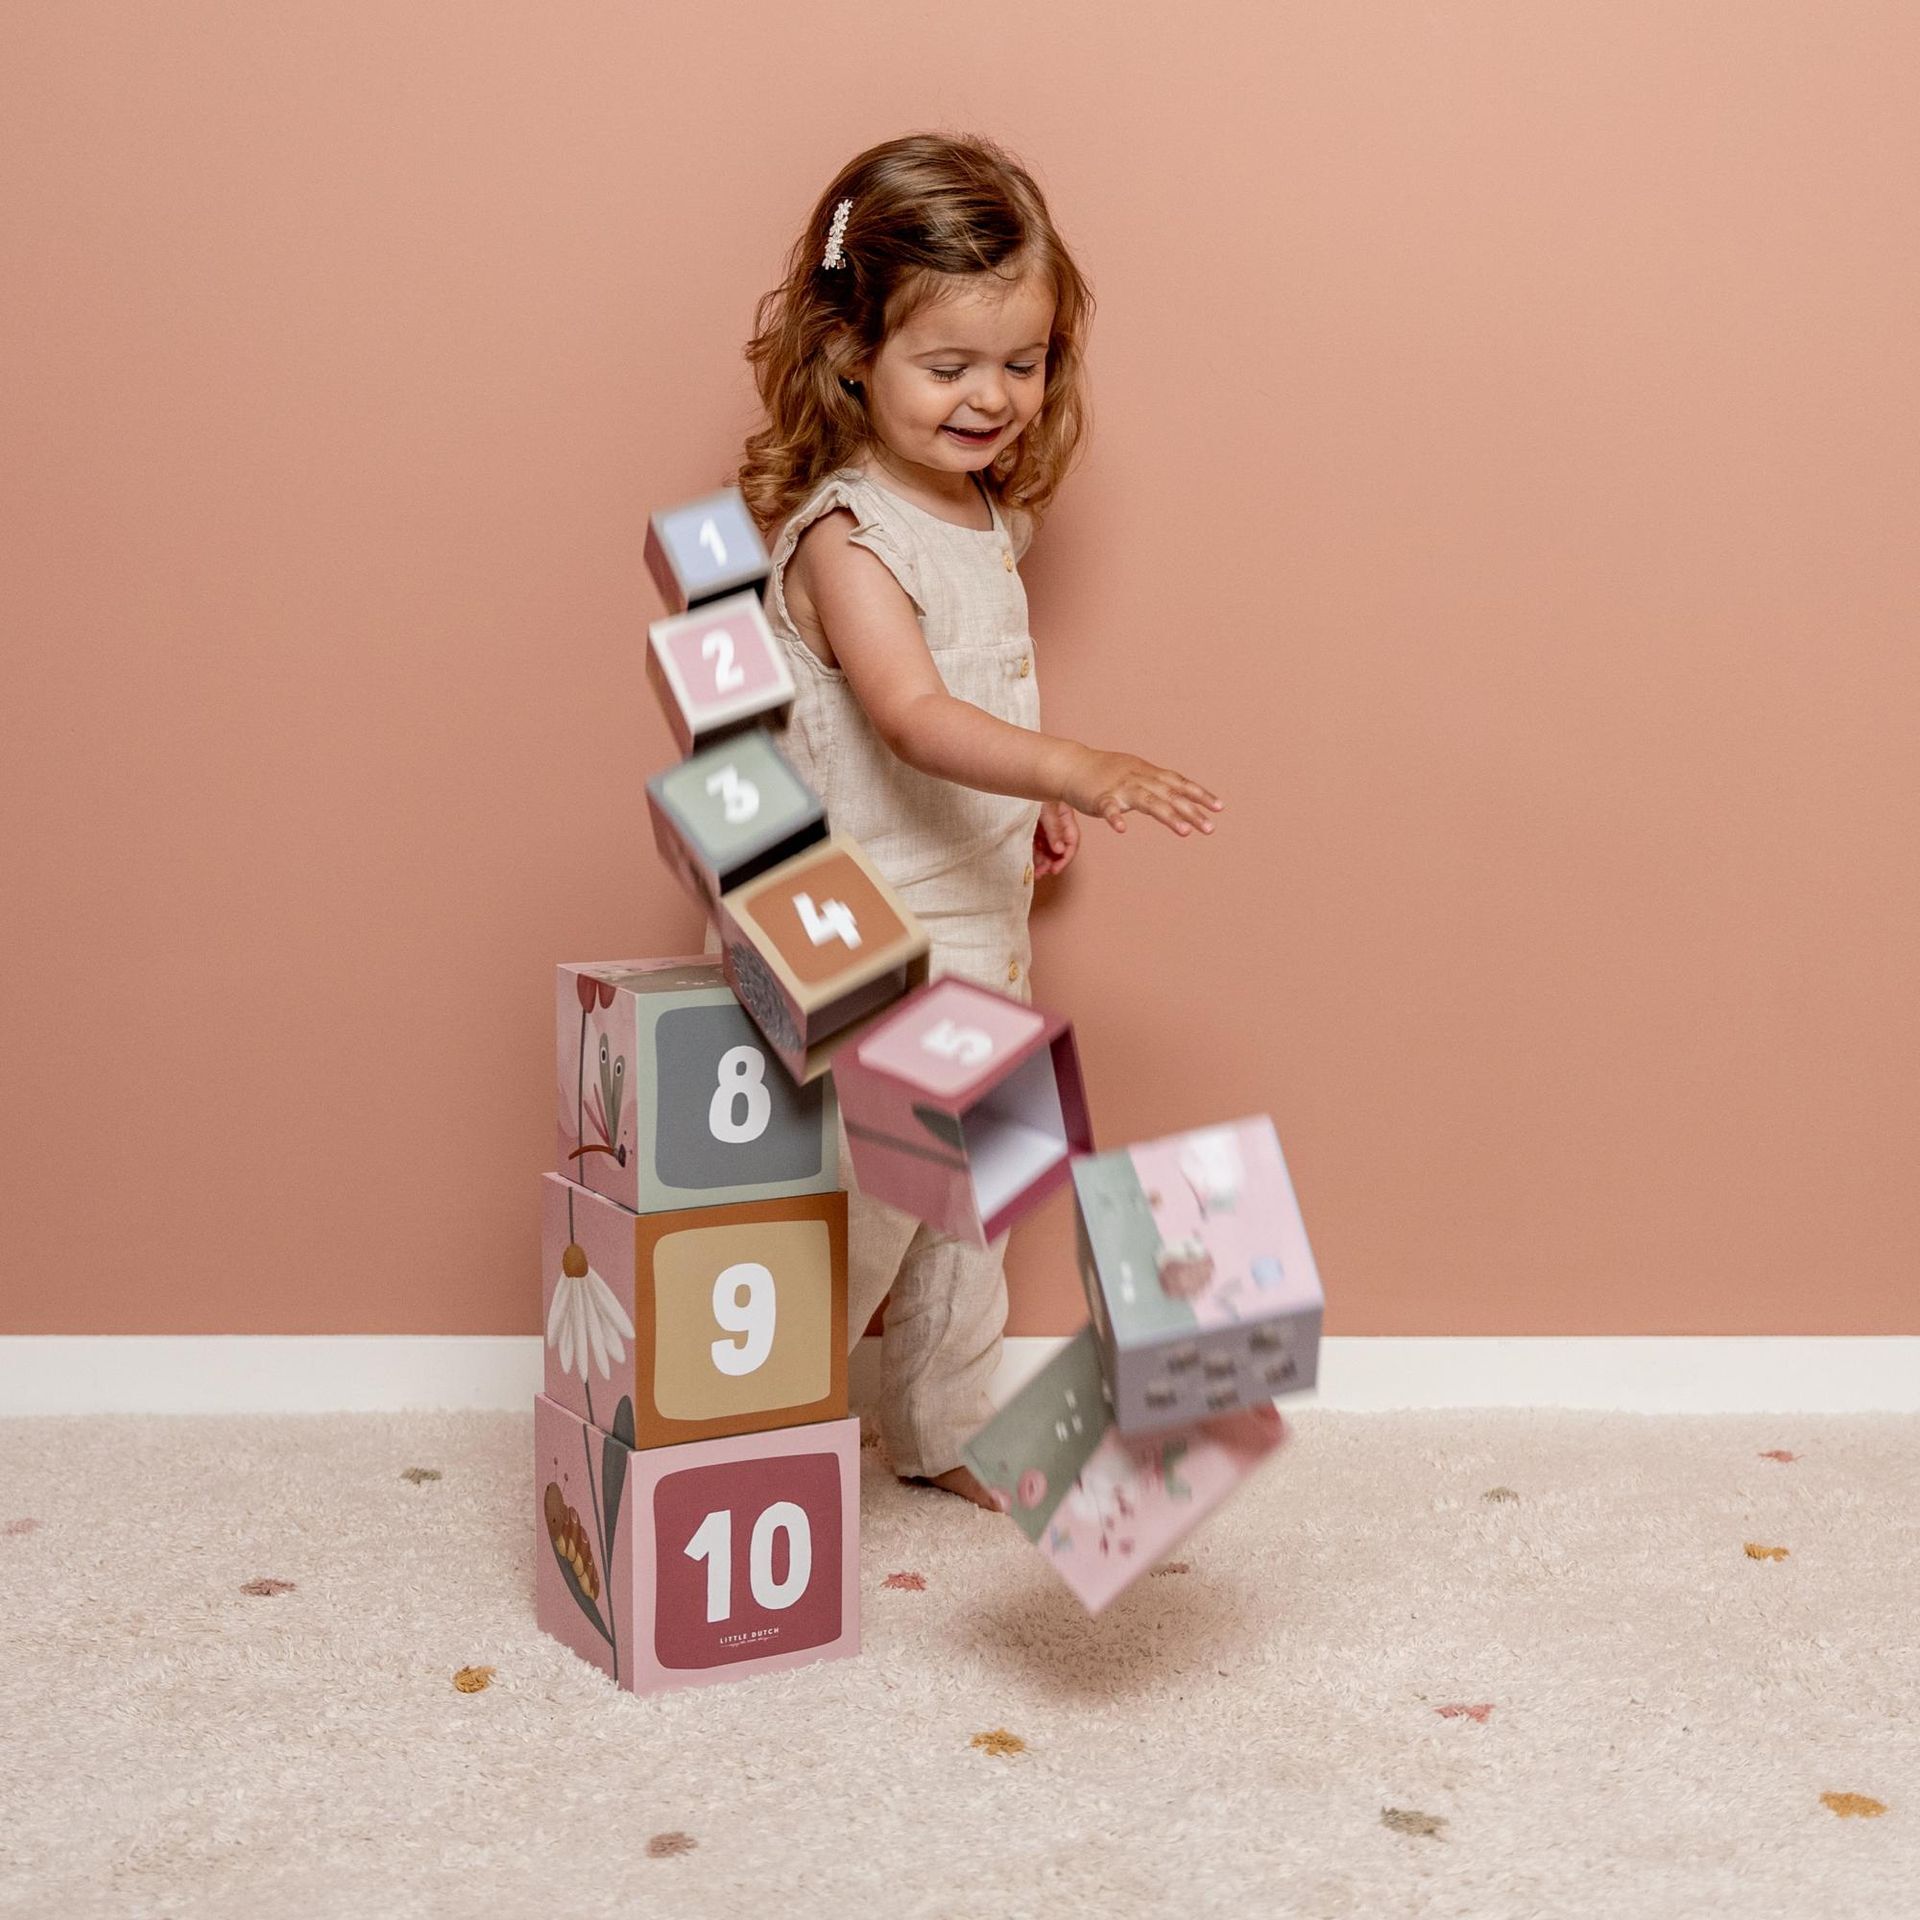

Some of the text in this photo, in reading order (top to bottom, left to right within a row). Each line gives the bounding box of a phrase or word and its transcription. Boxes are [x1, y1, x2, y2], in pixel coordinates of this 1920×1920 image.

[699, 517, 728, 567] 1
[702, 629, 745, 693] 2
[706, 764, 760, 824] 3
[792, 892, 862, 950] 4
[920, 1019, 993, 1066] 5
[708, 1045, 771, 1144] 8
[711, 1262, 777, 1376] 9
[684, 1501, 811, 1623] 10
[720, 1633, 747, 1645] LITTLE
[751, 1627, 779, 1638] DUTCH
